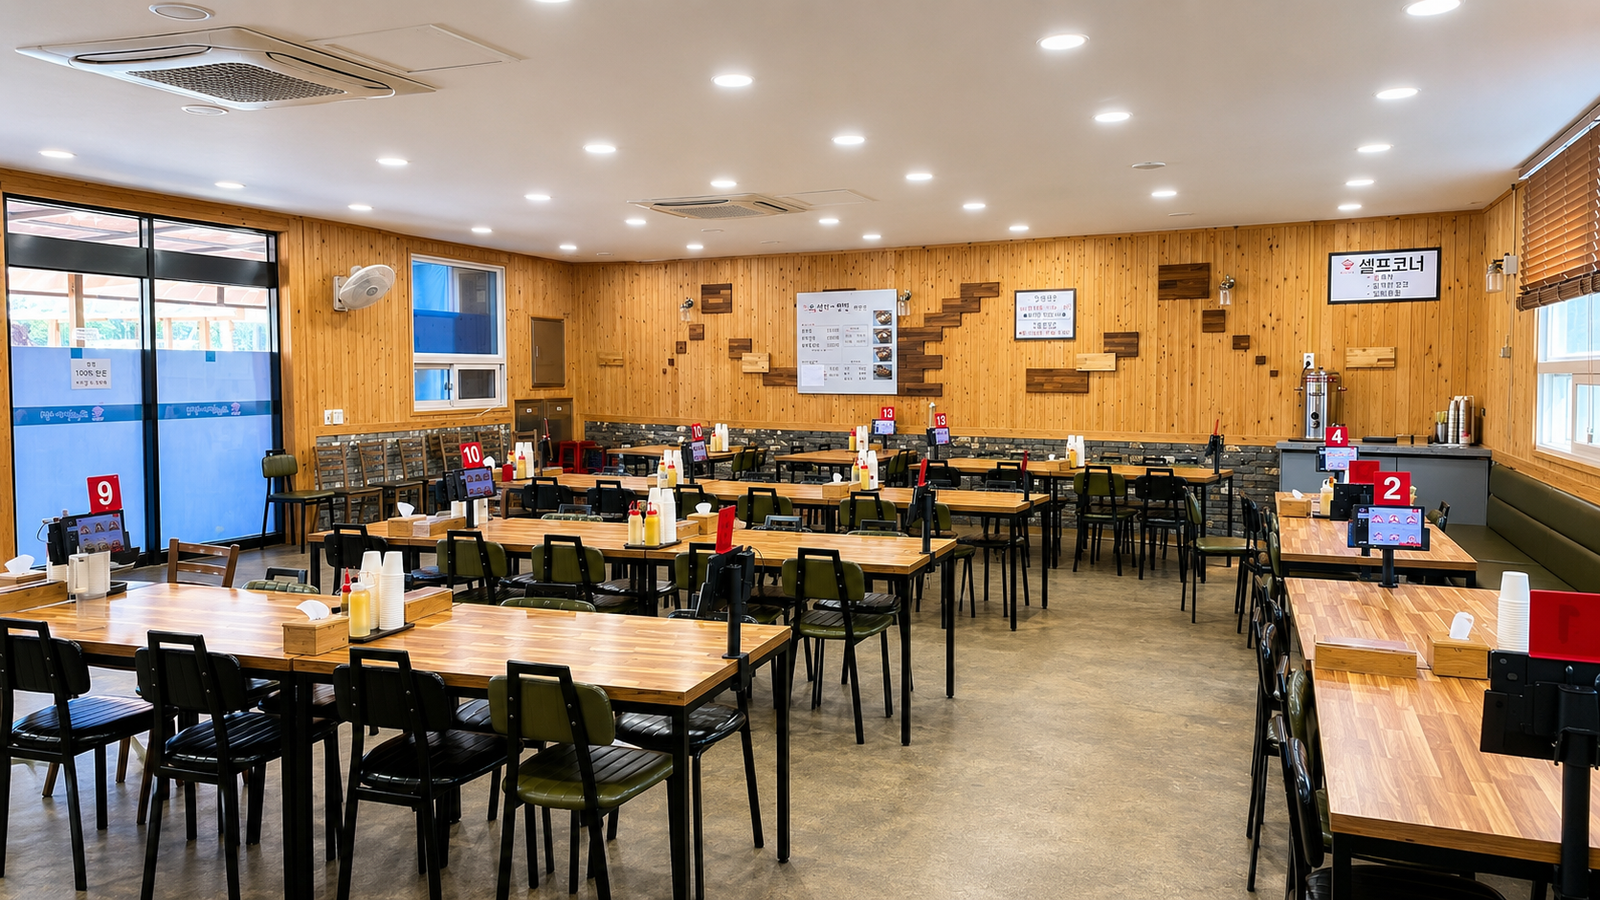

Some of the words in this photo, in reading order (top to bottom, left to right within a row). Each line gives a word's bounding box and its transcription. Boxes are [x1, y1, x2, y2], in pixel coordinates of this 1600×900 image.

[1359, 255, 1424, 274] 셀프코너
[883, 408, 893, 418] 13
[936, 415, 946, 426] 13
[693, 425, 702, 438] 10
[1331, 429, 1343, 444] 4
[463, 445, 481, 464] 10
[97, 481, 113, 505] 9
[1383, 476, 1401, 500] 2
